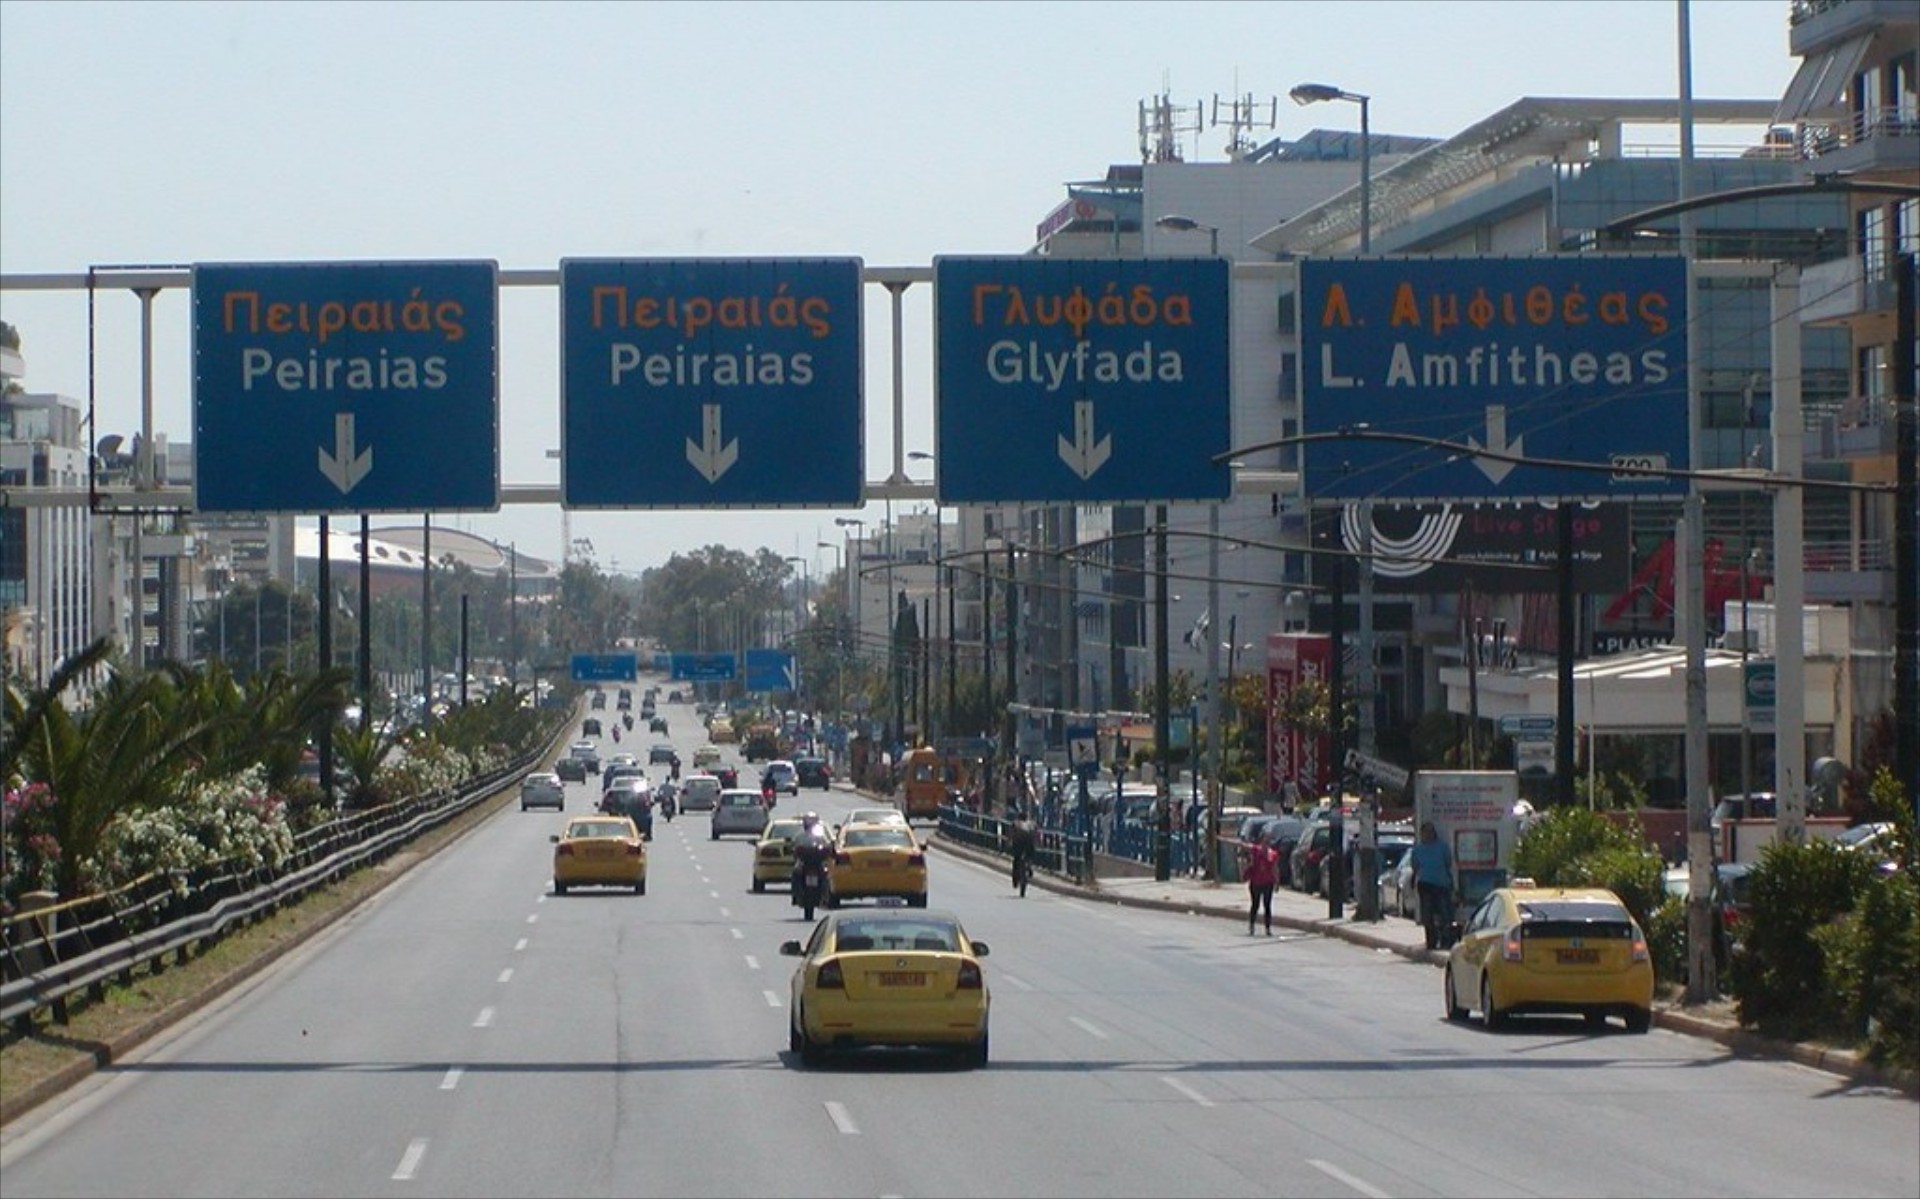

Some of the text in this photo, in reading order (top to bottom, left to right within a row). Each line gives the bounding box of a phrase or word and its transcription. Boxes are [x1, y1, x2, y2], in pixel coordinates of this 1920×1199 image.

[223, 287, 464, 341] Πειραιάς
[592, 284, 829, 337] Πειραιάς
[972, 283, 1192, 337] Γλυφάδα
[1322, 283, 1668, 334] Λ. Αμφιθέας
[243, 349, 447, 390] Peiraias
[611, 342, 813, 386] Peiraias
[986, 340, 1183, 391] Glyfada
[1322, 342, 1668, 387] L. Amfitheas
[1533, 514, 1601, 538] Stge
